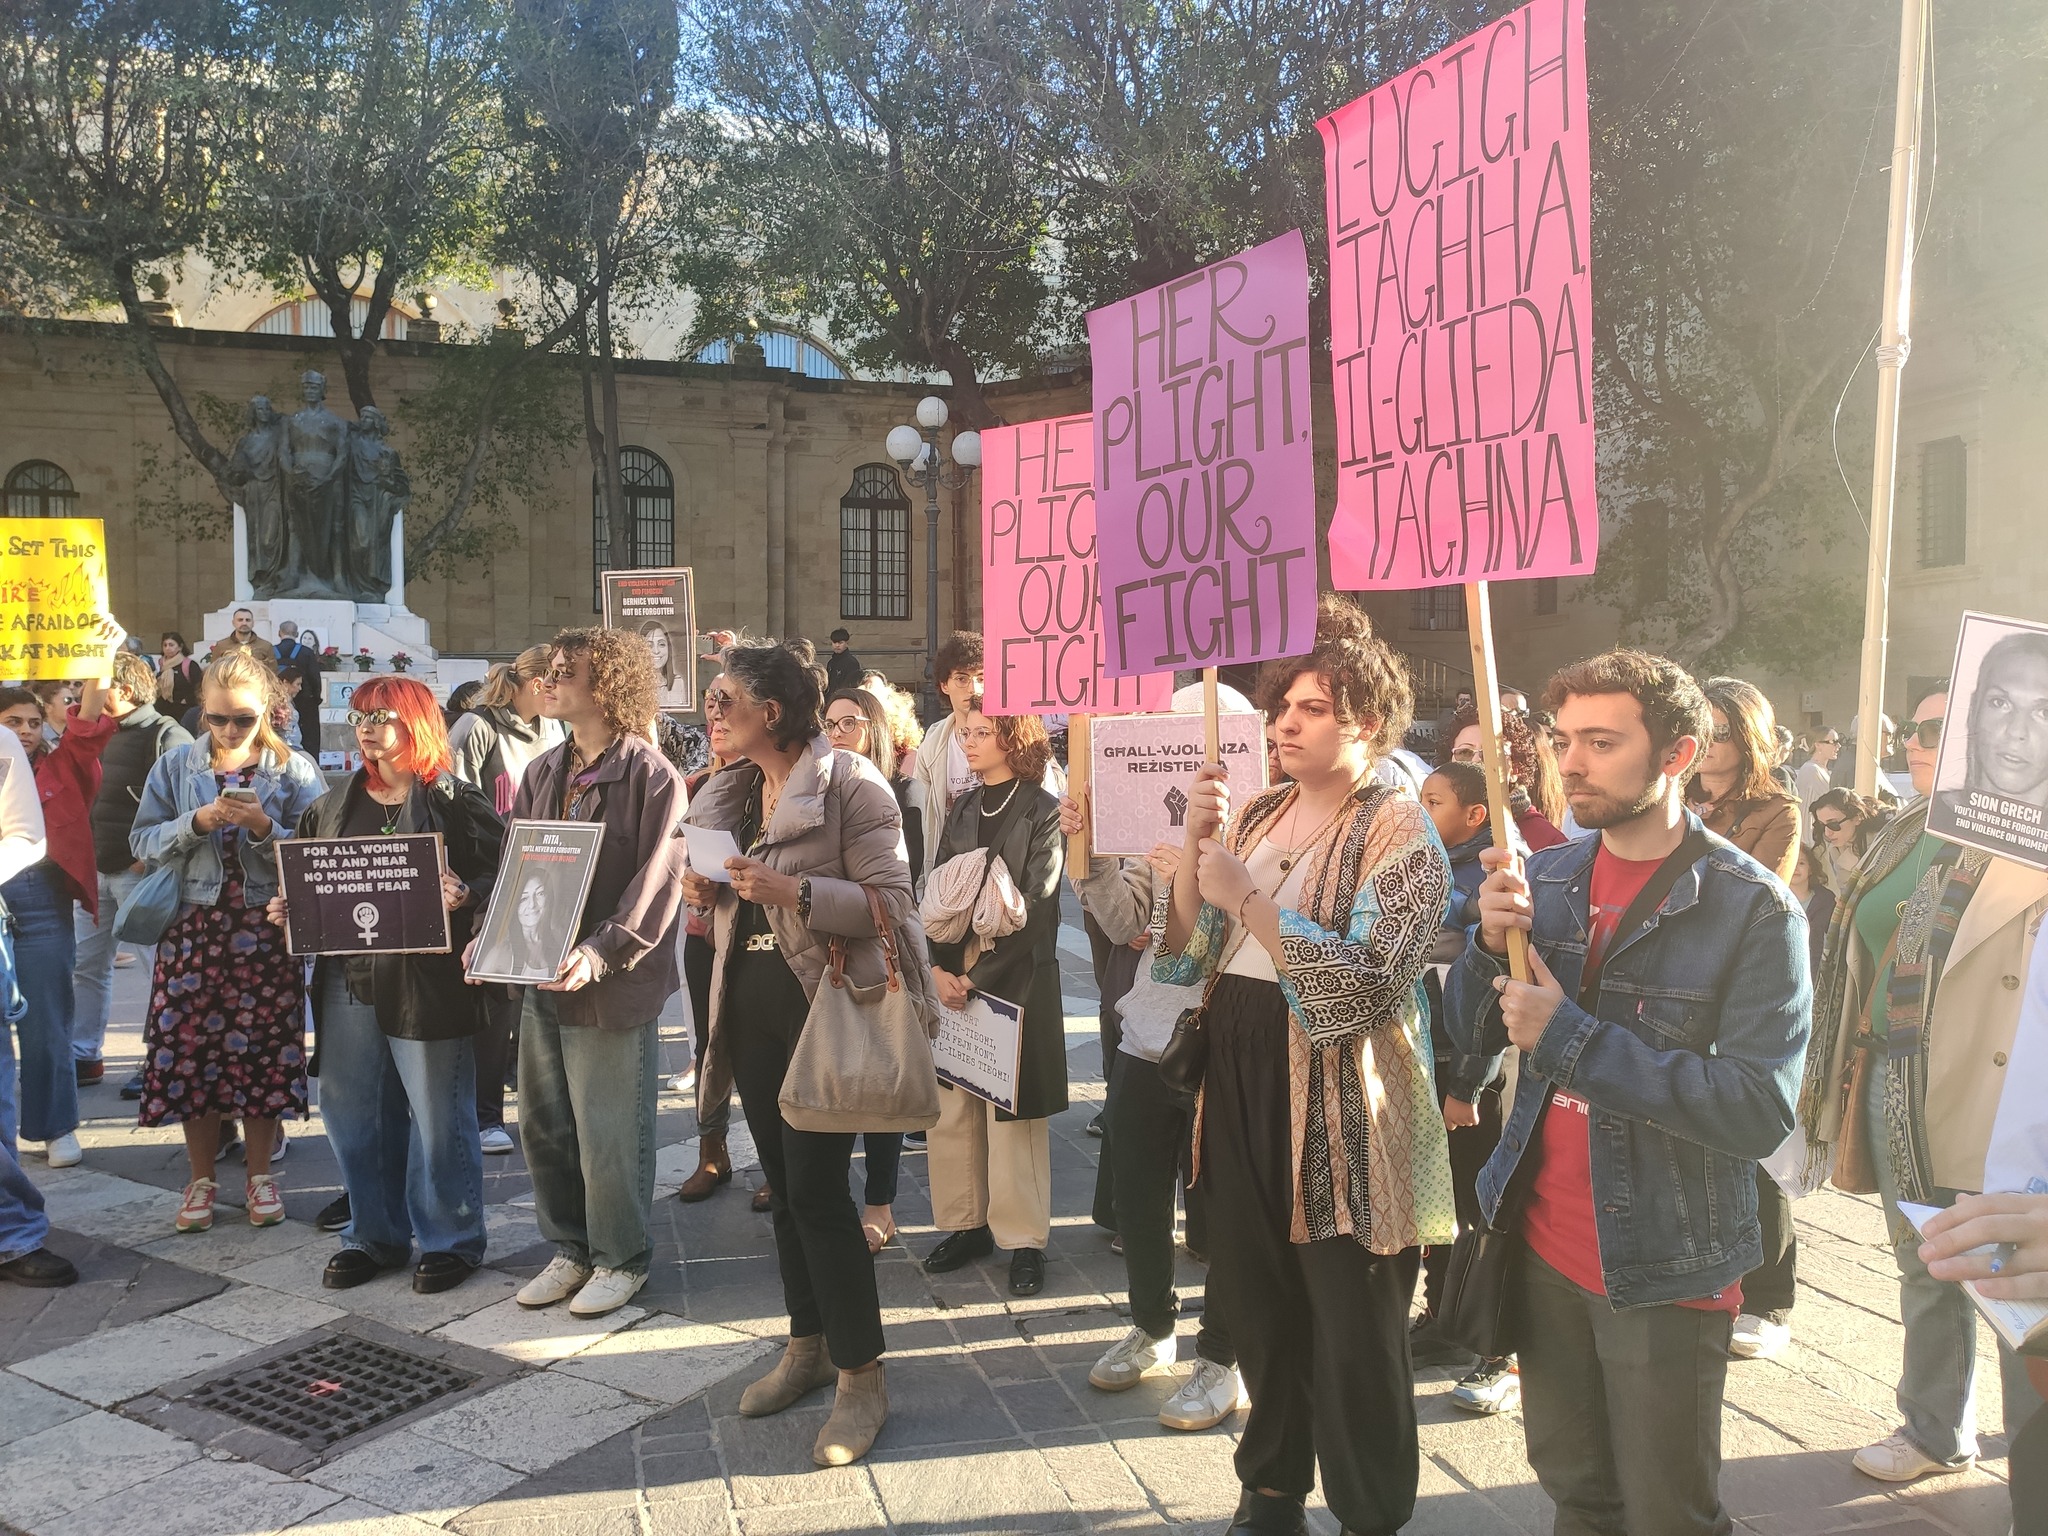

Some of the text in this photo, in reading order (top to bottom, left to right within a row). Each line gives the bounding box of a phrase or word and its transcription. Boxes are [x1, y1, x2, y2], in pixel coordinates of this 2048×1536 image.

[1130, 260, 1276, 389] HER
[1102, 336, 1309, 491] PLIGHT,
[1016, 417, 1094, 496] HE
[1136, 458, 1273, 570] OUR
[990, 489, 1097, 566] PLIG
[9, 536, 96, 558] SET THIS
[1, 586, 41, 603] IRE
[622, 596, 674, 606] BERNICE YOU WILL
[622, 607, 675, 616] NOT BE FORGOTTEN
[1114, 547, 1306, 670] FIGHT
[20, 643, 44, 659] AT
[46, 643, 108, 659] NIGHT
[1001, 633, 1142, 709] FIGH
[1127, 759, 1229, 774] REŻISTENA
[1969, 792, 2043, 825] SION GRECH
[1954, 804, 2048, 840] YOU'LL NEVER BE FORGOTTE
[542, 834, 563, 847] RITA,
[1955, 817, 2048, 853] END VIOLENCE ON WOMEN
[303, 842, 409, 857] FOR ALL WOMEN
[312, 855, 408, 869] FAR AND NEAR
[304, 867, 419, 882] NO MORE MURDER
[315, 880, 411, 895] NO MORE FEAR
[939, 1015, 950, 1028] UX
[952, 1034, 973, 1052] FEJN
[974, 1044, 997, 1065] KONT,
